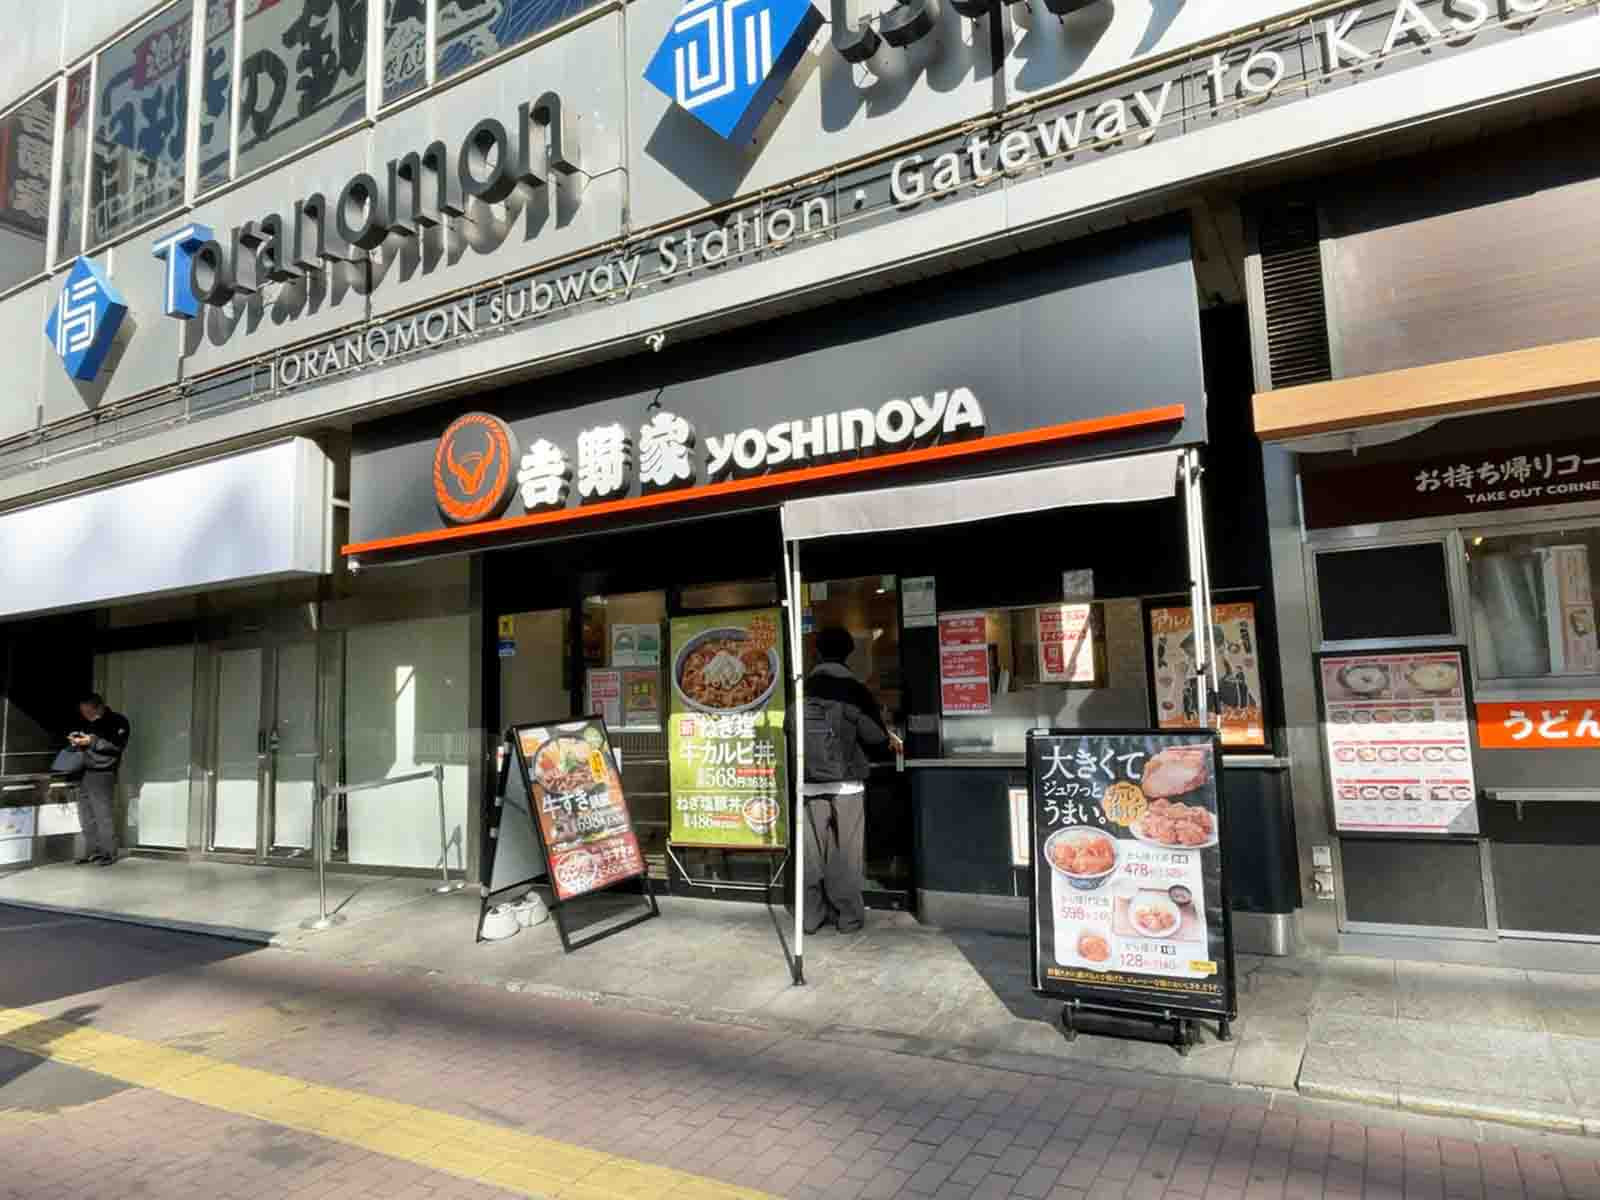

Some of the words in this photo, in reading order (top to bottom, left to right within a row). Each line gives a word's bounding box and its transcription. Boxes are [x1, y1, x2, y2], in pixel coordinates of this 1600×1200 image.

[489, 254, 640, 323] subway
[657, 197, 829, 274] Station
[890, 81, 1173, 202] Gateway
[1207, 51, 1285, 104] to
[152, 91, 579, 319] Toranomon
[705, 387, 985, 475] YOSHINOYA
[1465, 491, 1505, 504] TAKE
[1509, 486, 1543, 499] OUT
[1503, 708, 1600, 741] うどん
[1041, 745, 1145, 780] 大きくて
[1043, 782, 1103, 798] ジュワっと
[1043, 799, 1107, 825] うまい。
